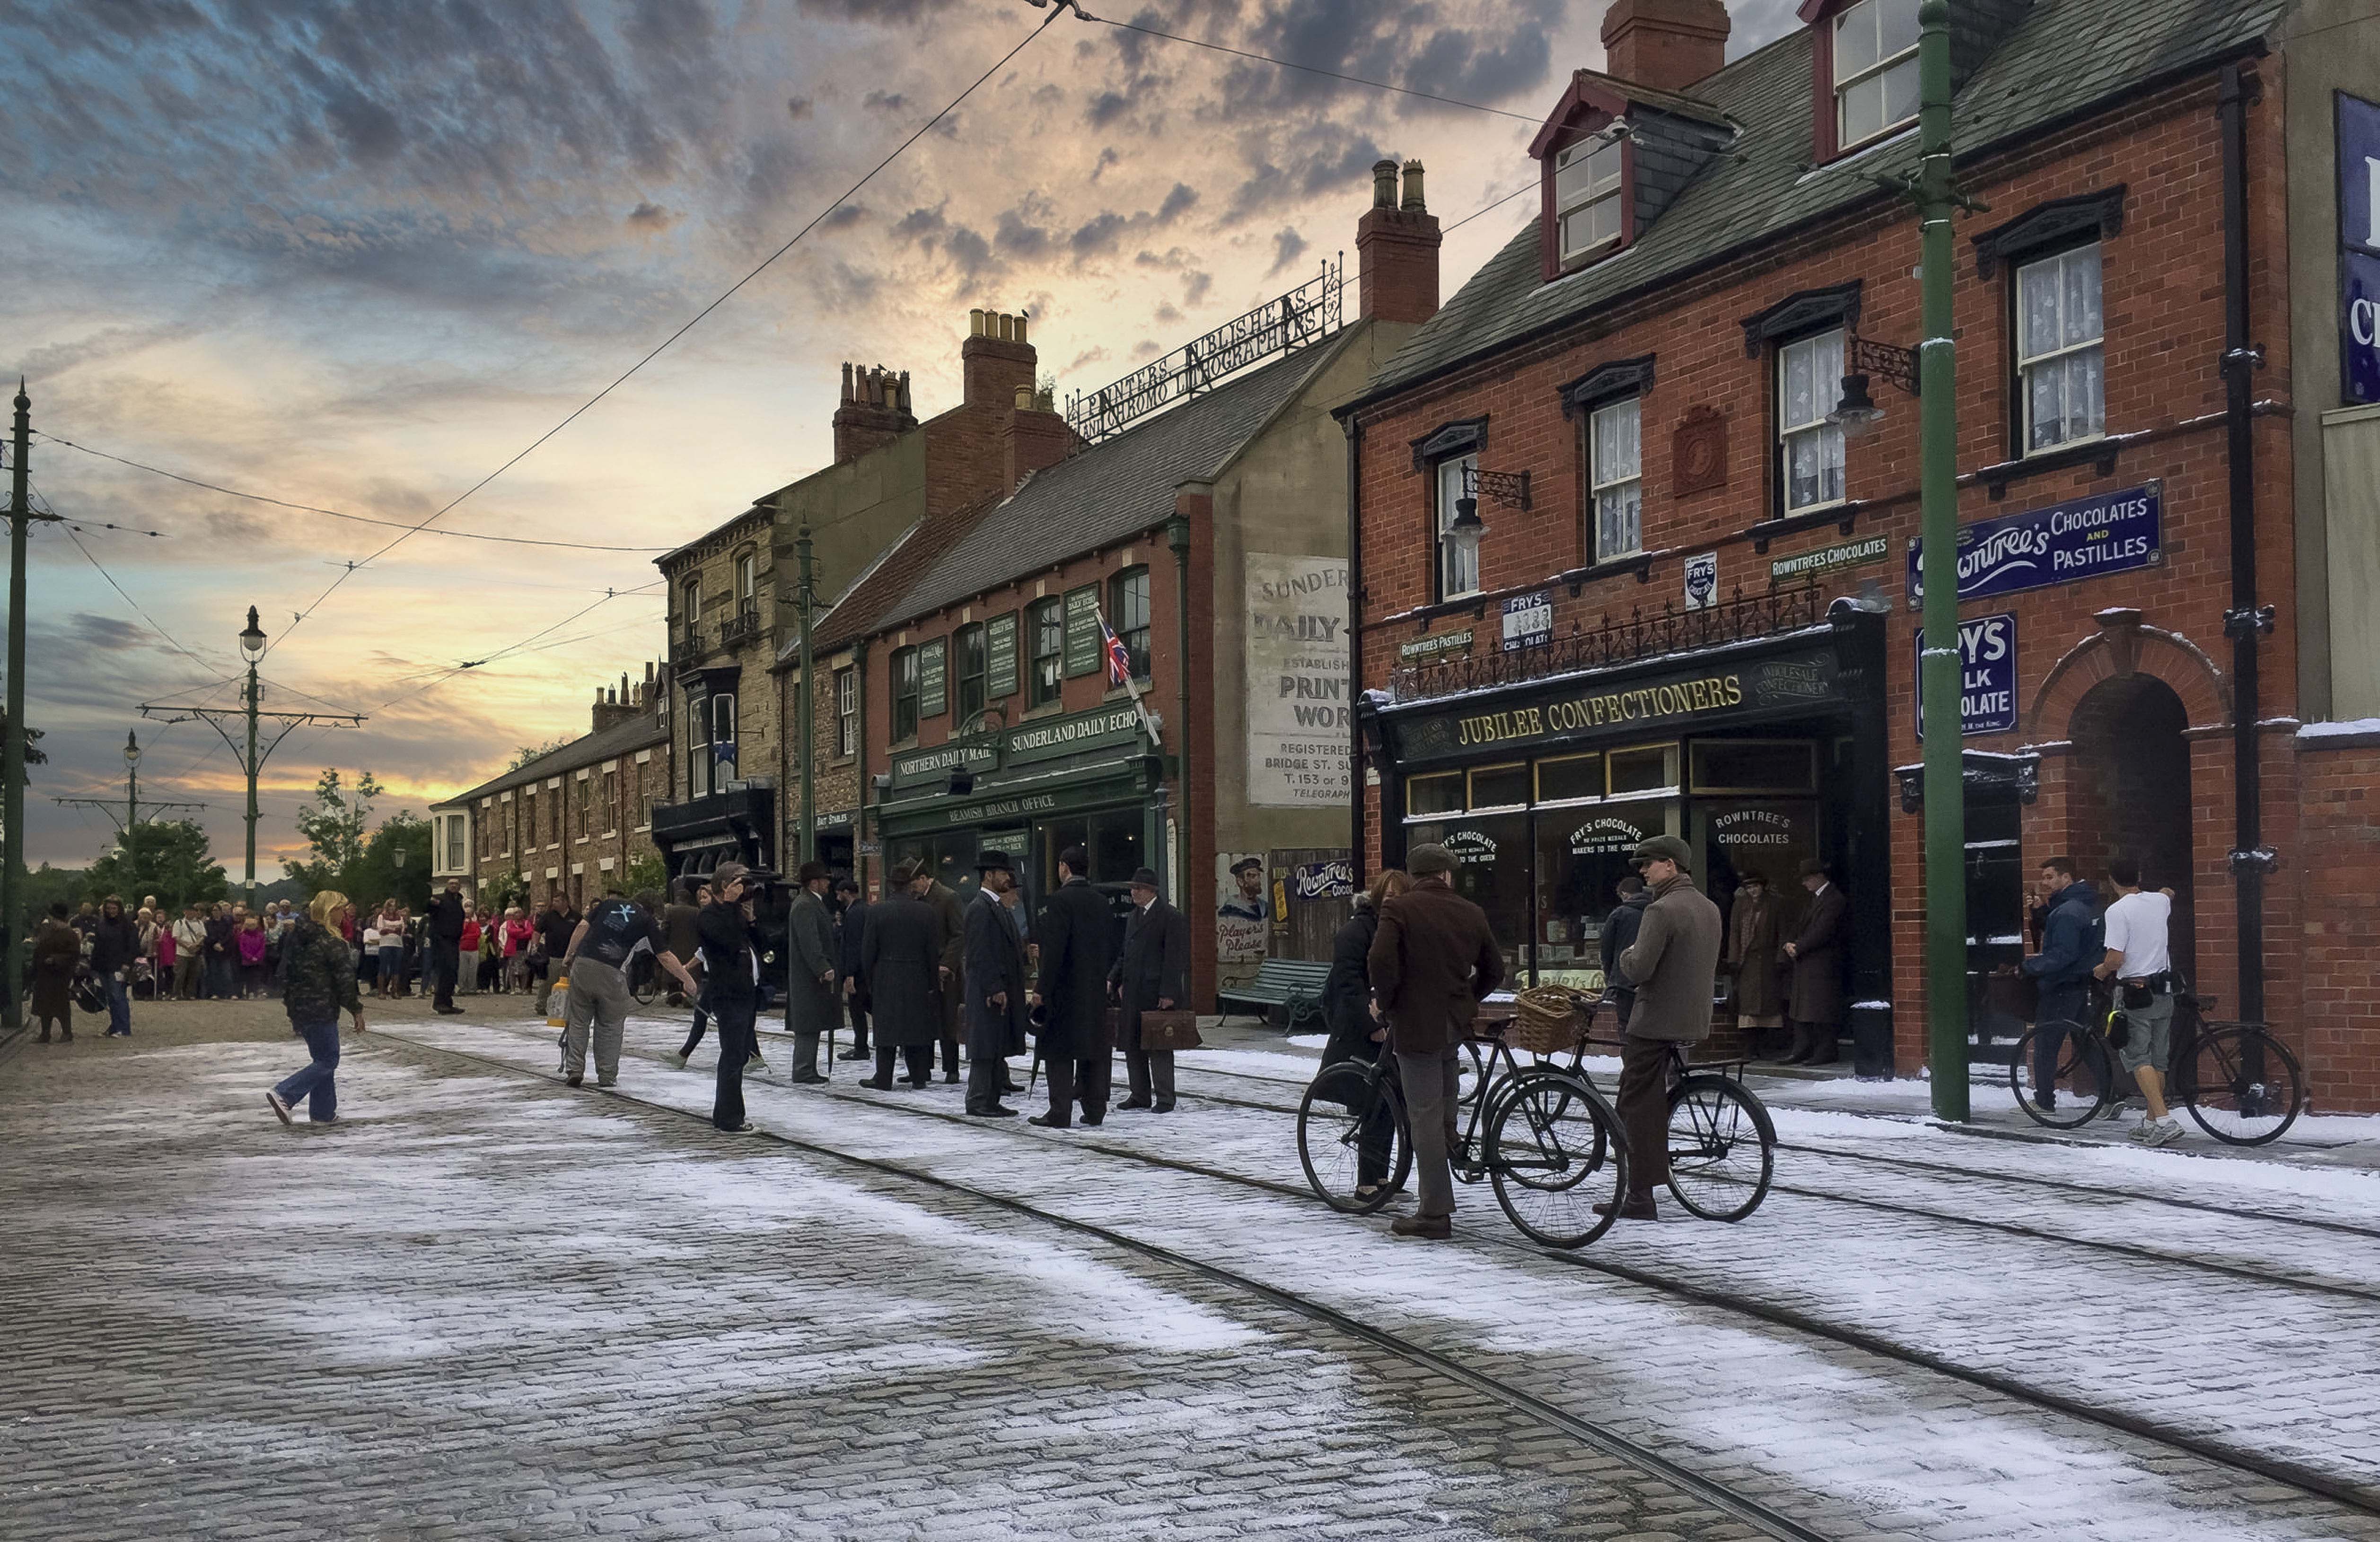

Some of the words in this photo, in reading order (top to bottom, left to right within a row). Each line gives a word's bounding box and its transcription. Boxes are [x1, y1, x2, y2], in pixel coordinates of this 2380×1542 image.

[2051, 498, 2148, 535] CHOCOLATES
[2087, 530, 2109, 542] AND
[1827, 539, 1887, 564] CHOCOLATES
[2054, 536, 2147, 570] PASTILLES
[1439, 632, 1472, 648] PASTILLES
[1958, 620, 2006, 664] Y'S
[1965, 669, 1992, 689] LK
[1459, 707, 1543, 745] JUBILEE
[1548, 675, 1741, 730] CONFECTIONERS
[1012, 724, 1075, 752] SUNDERLAND
[1077, 717, 1107, 738] DAILY
[1109, 710, 1136, 731] ECHO
[900, 756, 941, 776] NORTHERN
[969, 749, 991, 761] MAIL
[1265, 758, 1309, 770] BRIDGE
[1313, 760, 1330, 770] ST.
[1022, 795, 1054, 810] OFFICE
[1570, 823, 1592, 845] FRY'S
[1595, 818, 1642, 841] CHOCOLATE
[1715, 811, 1791, 828] ROWNTREE'S
[1458, 832, 1497, 852] CHOCOLATE
[1718, 834, 1789, 843] CHOCOLATES
[1297, 863, 1353, 896] Rowntree's
